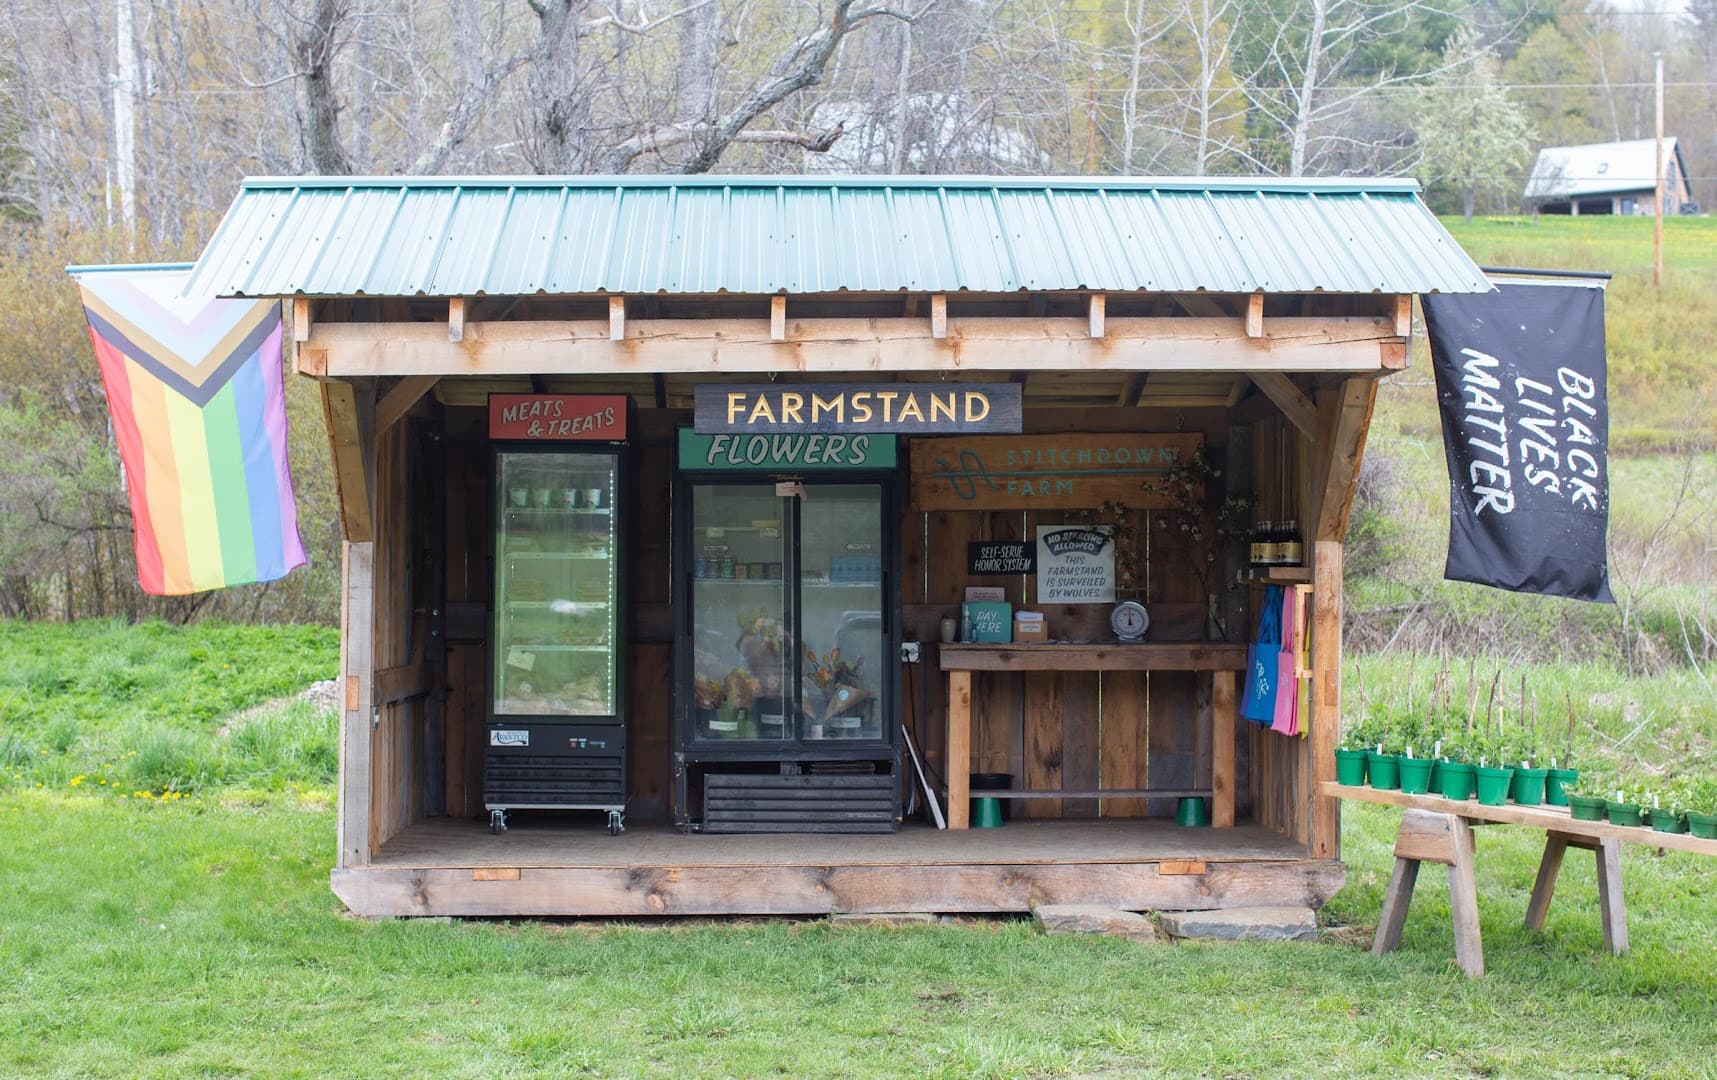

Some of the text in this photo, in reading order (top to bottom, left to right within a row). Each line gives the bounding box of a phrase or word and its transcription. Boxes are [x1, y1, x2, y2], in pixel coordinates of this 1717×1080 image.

[502, 399, 565, 425] MEATS
[727, 391, 991, 425] FARMSTAND
[547, 407, 615, 436] TREATS
[1460, 347, 1516, 516] MATTER
[1514, 376, 1561, 495] LIVES
[1557, 366, 1599, 511] BLACK
[707, 433, 870, 465] FLOWERS
[1007, 447, 1174, 466] STITCHDOWN
[1007, 480, 1074, 496] FARM
[1048, 534, 1061, 545] NO
[1054, 542, 1095, 551] ALLOWED
[980, 545, 1024, 559] SELF-SERVE
[974, 558, 1032, 572] HONOR SYSTEM
[1064, 555, 1086, 565] THIS
[1047, 566, 1104, 576] FARMSTAND
[1046, 577, 1106, 587] IS SURVEILED
[1049, 588, 1062, 598] BY
[976, 611, 997, 622] PAY
